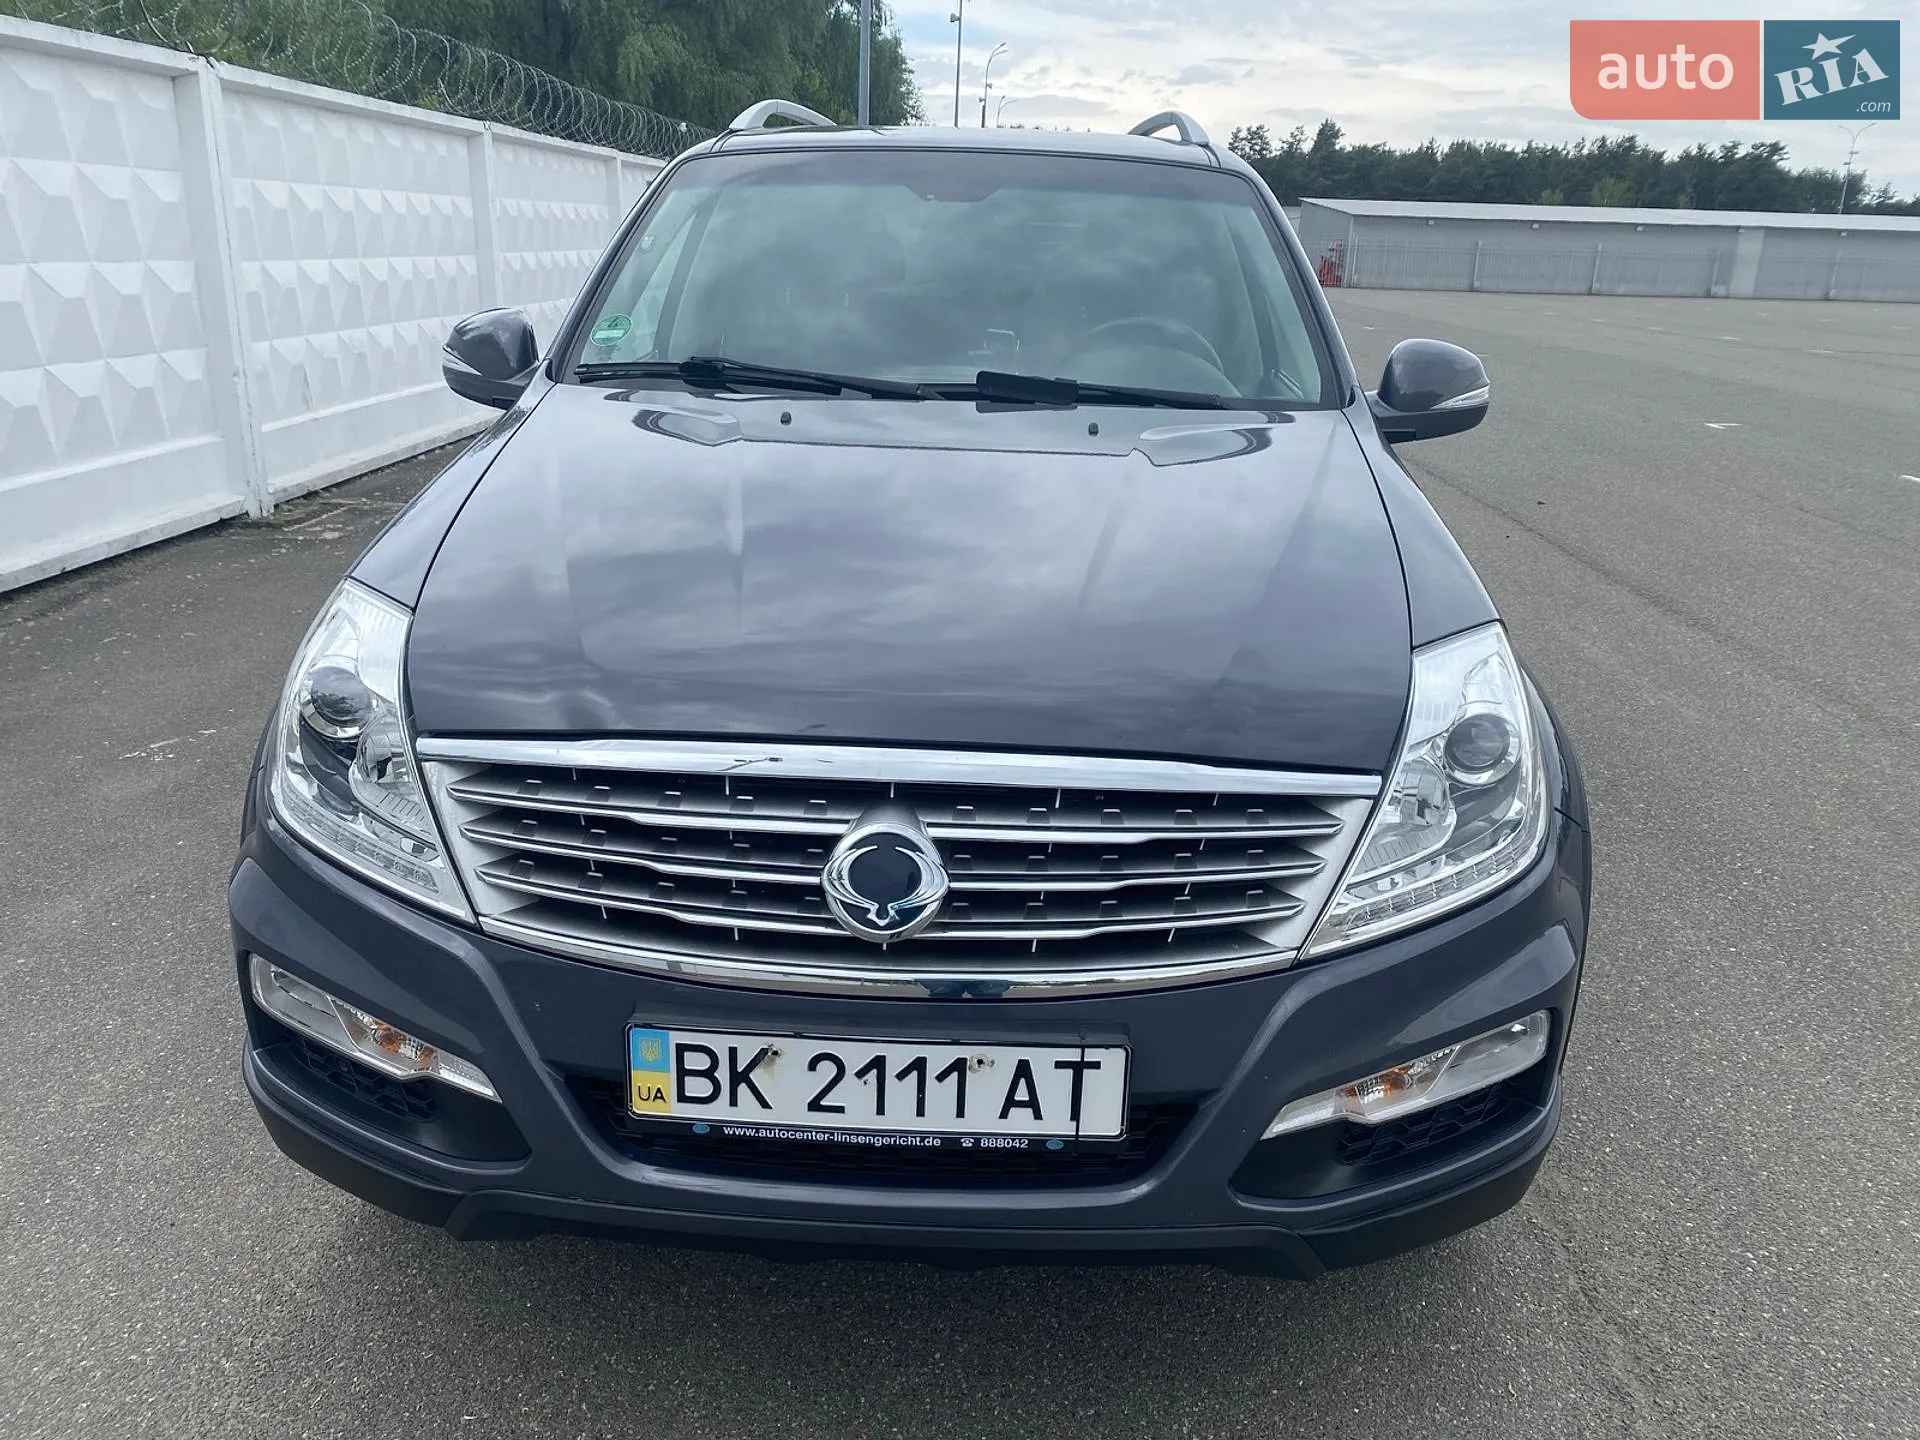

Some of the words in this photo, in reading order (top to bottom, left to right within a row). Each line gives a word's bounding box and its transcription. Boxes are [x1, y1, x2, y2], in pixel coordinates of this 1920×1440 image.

[637, 1084, 668, 1104] UA
[674, 1042, 774, 1110] BK
[806, 1051, 968, 1119] 2111
[998, 1058, 1102, 1122] AT
[722, 1125, 942, 1148] www.autocenter-linsengericht.de
[980, 1137, 1029, 1149] 888042
